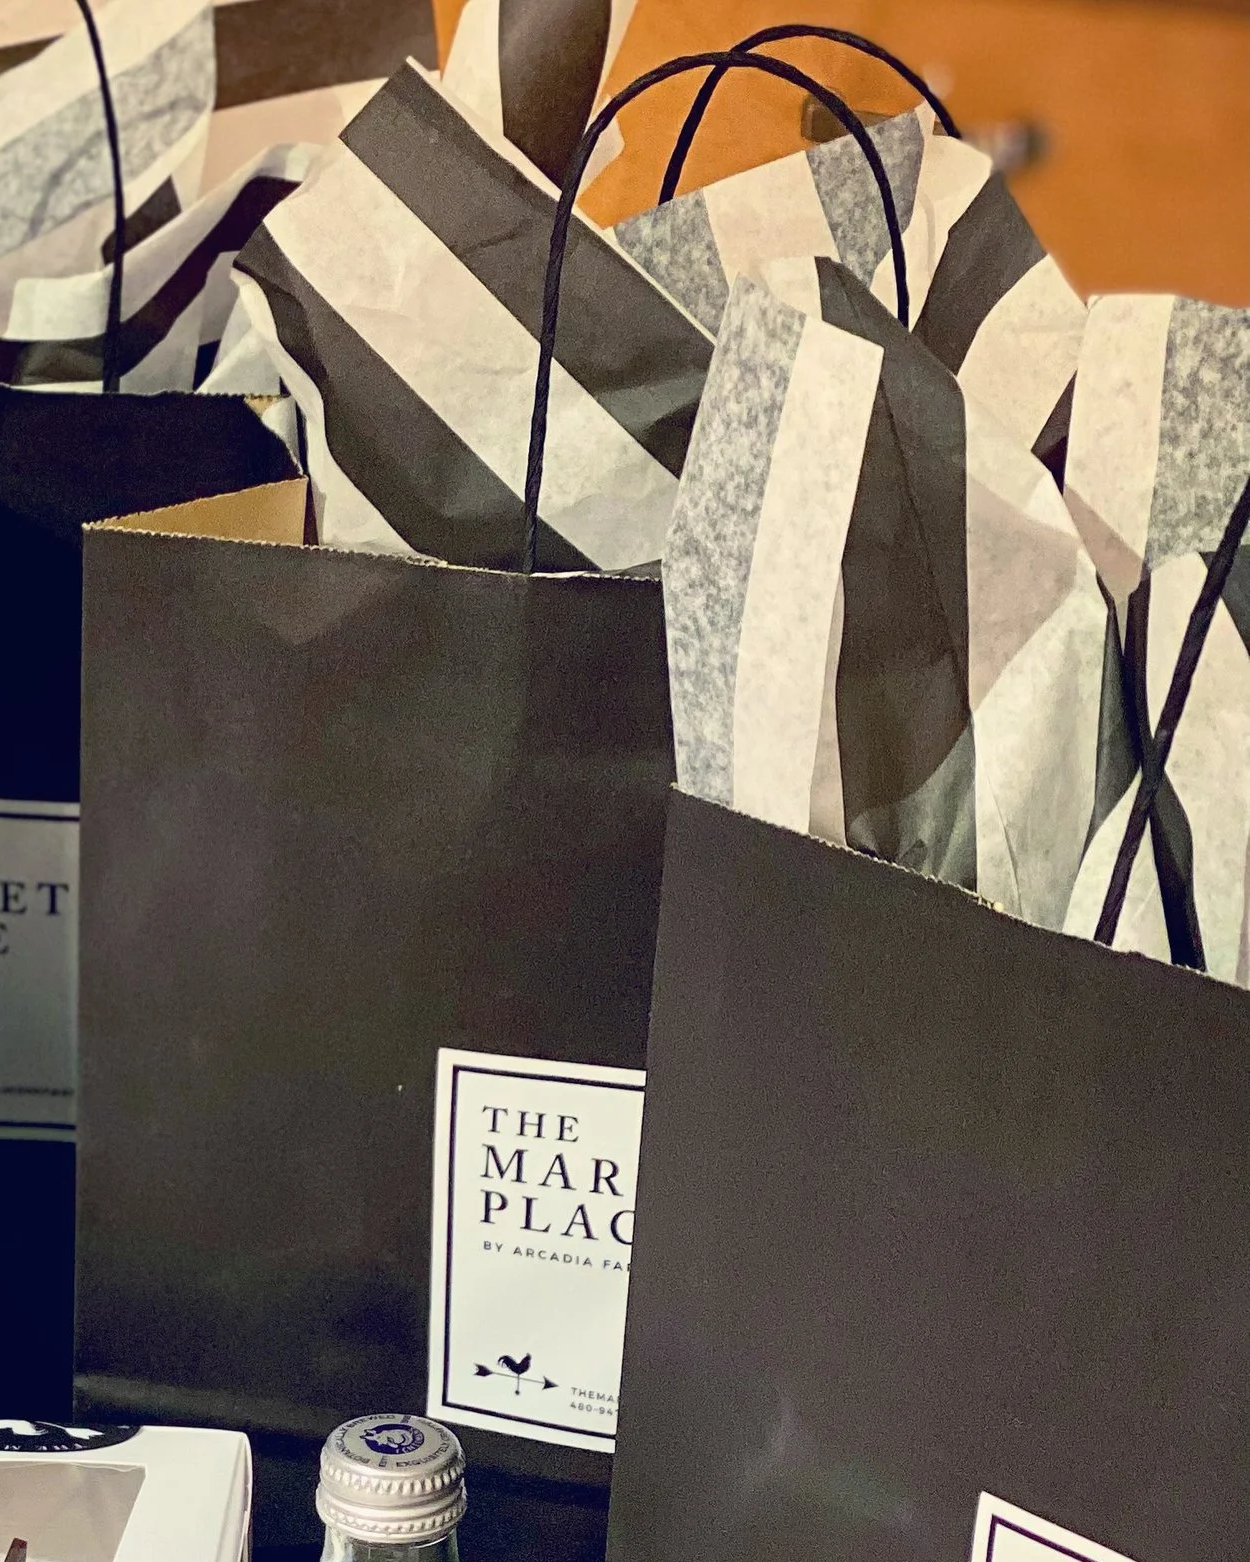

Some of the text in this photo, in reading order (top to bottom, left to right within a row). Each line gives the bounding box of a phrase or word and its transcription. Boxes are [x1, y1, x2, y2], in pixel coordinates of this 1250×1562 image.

[481, 1105, 580, 1143] THE
[480, 1144, 624, 1197] MAR
[480, 1189, 636, 1246] PLAC
[483, 1240, 503, 1254] BY
[513, 1246, 593, 1268] ARCADIA
[570, 1402, 618, 1416] 480-94
[571, 1387, 619, 1404] THEMA
